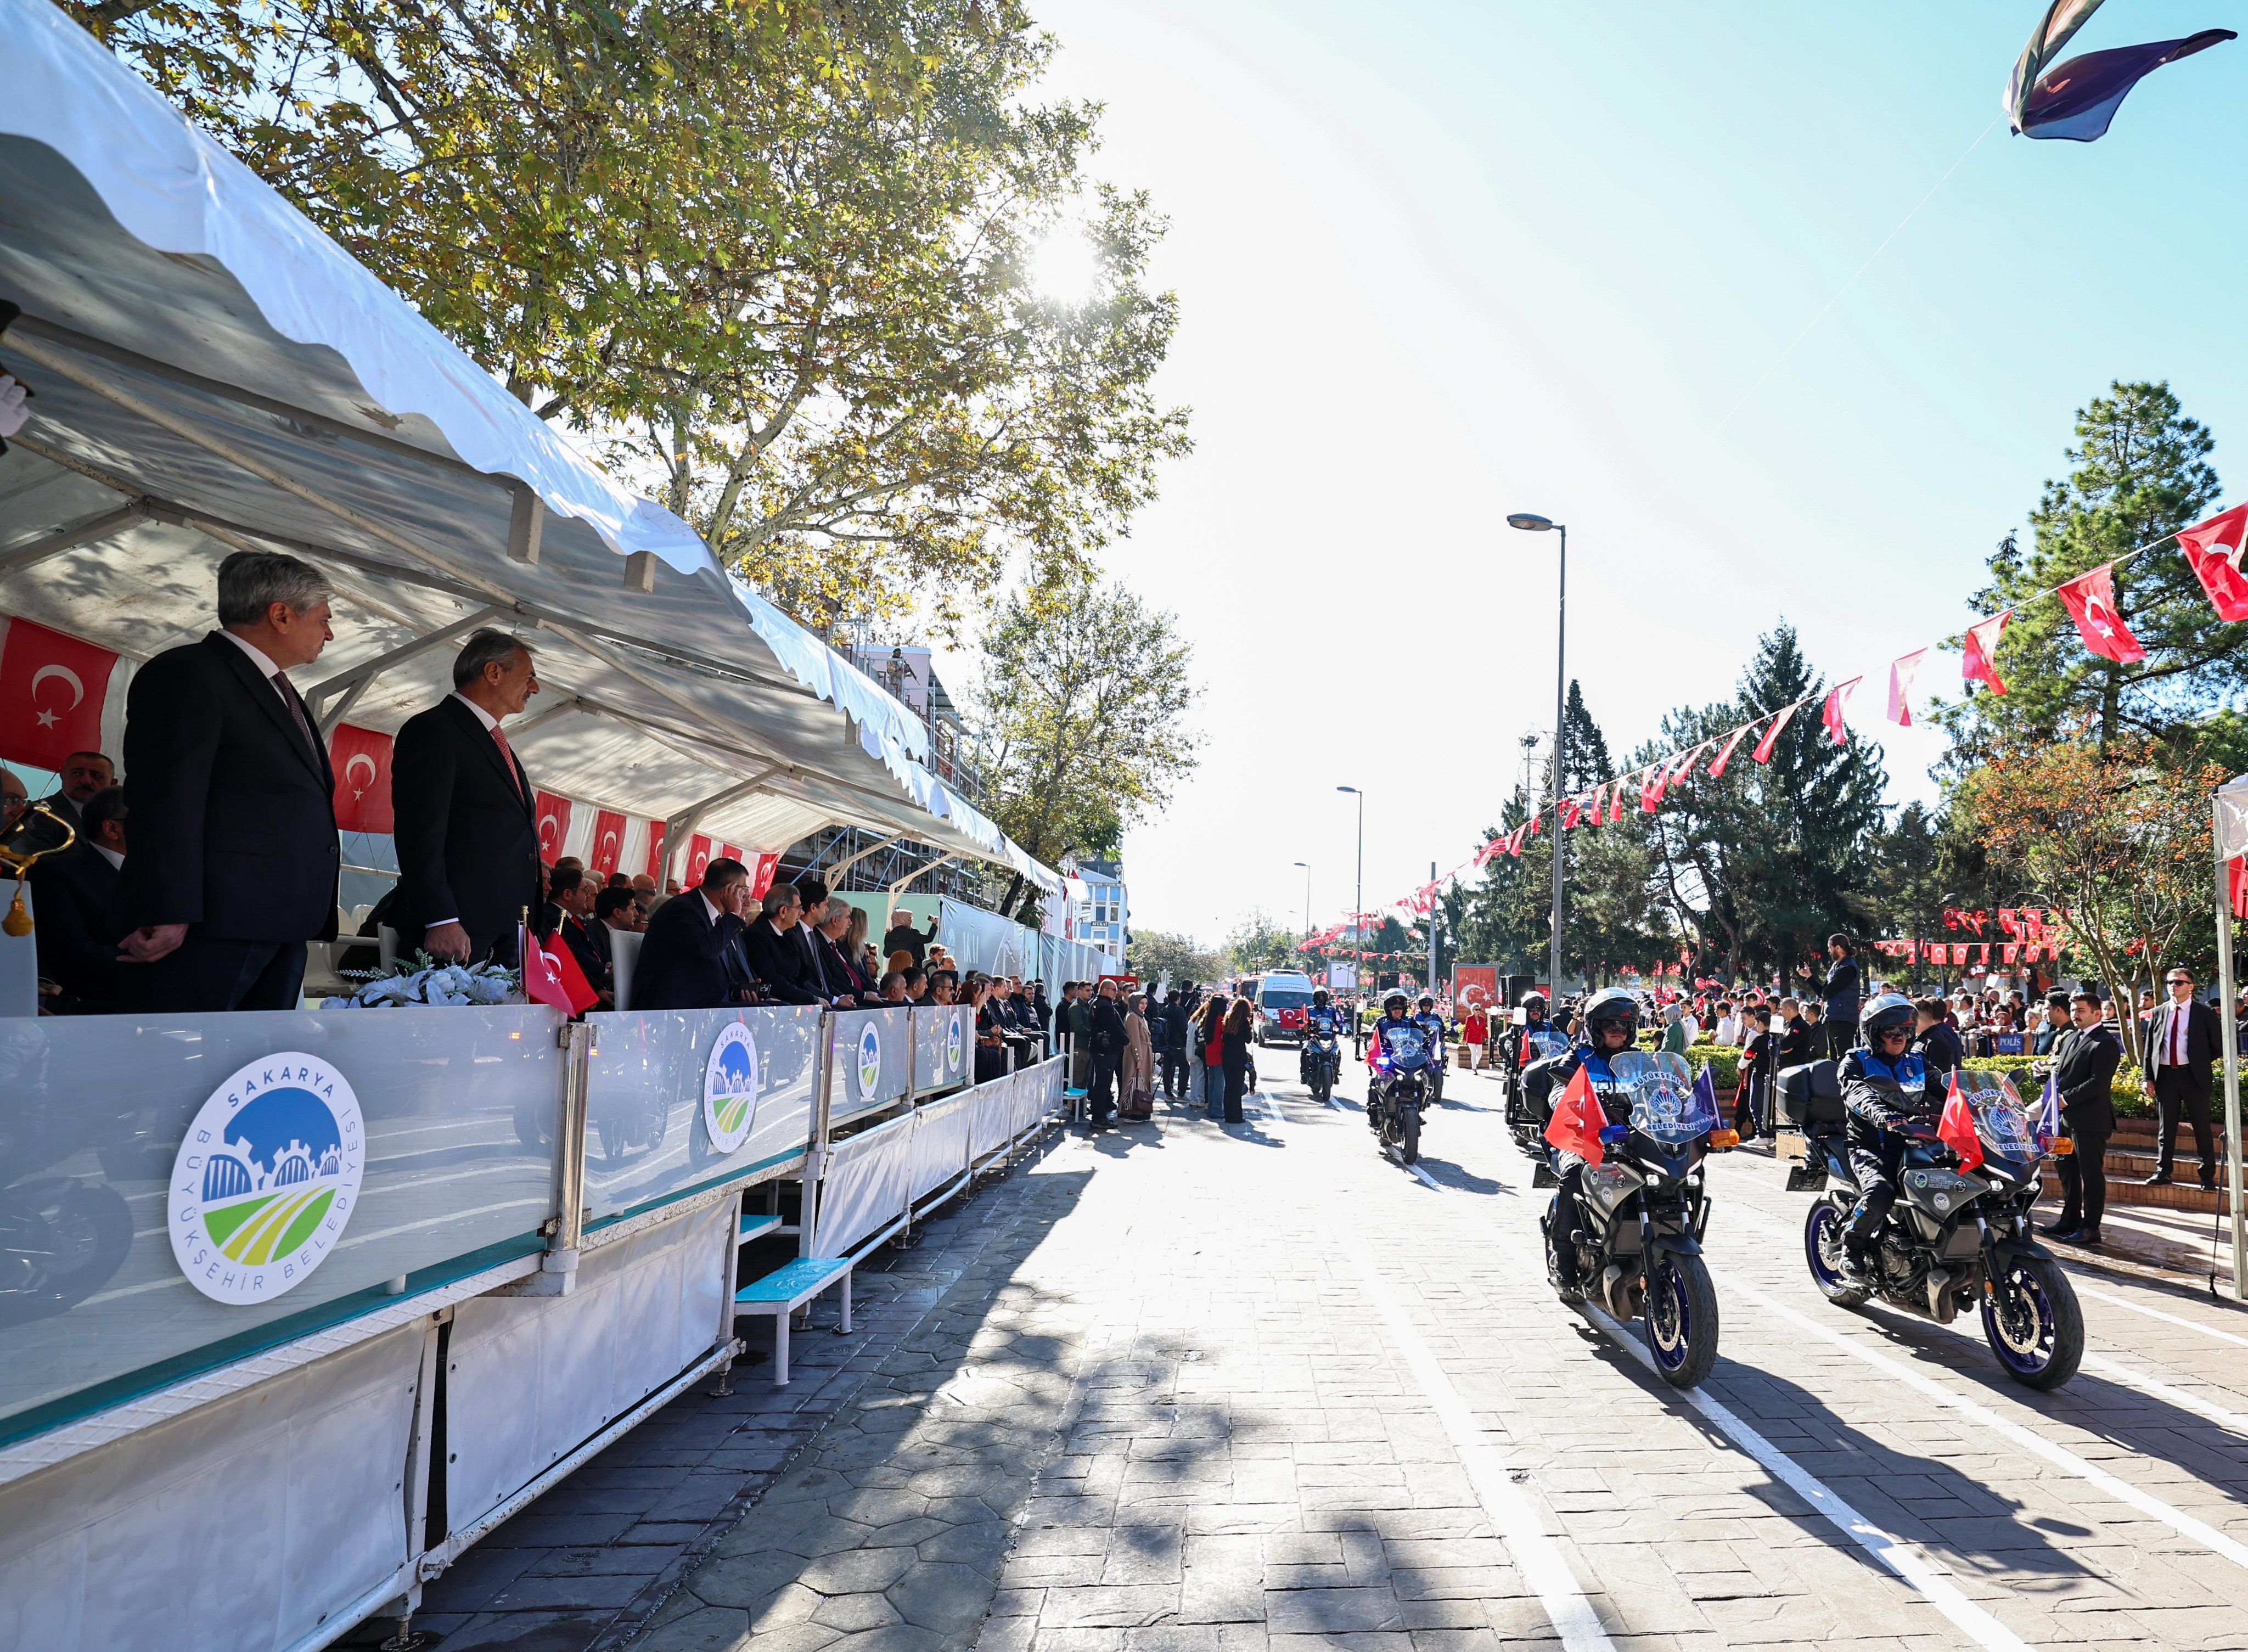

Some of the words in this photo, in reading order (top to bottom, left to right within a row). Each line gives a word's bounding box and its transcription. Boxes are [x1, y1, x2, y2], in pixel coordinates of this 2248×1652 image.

[721, 1030, 750, 1049] SAKARYA
[1999, 1037, 2021, 1046] POLİS
[228, 1066, 334, 1108] SAKARYA
[1633, 1071, 1685, 1089] BÜYÜKŞEHİR
[1646, 1122, 1695, 1131] BELEDİYESİ
[181, 1128, 264, 1290] BÜYÜKŞEHİR
[284, 1108, 358, 1279] BELEDİYESİ
